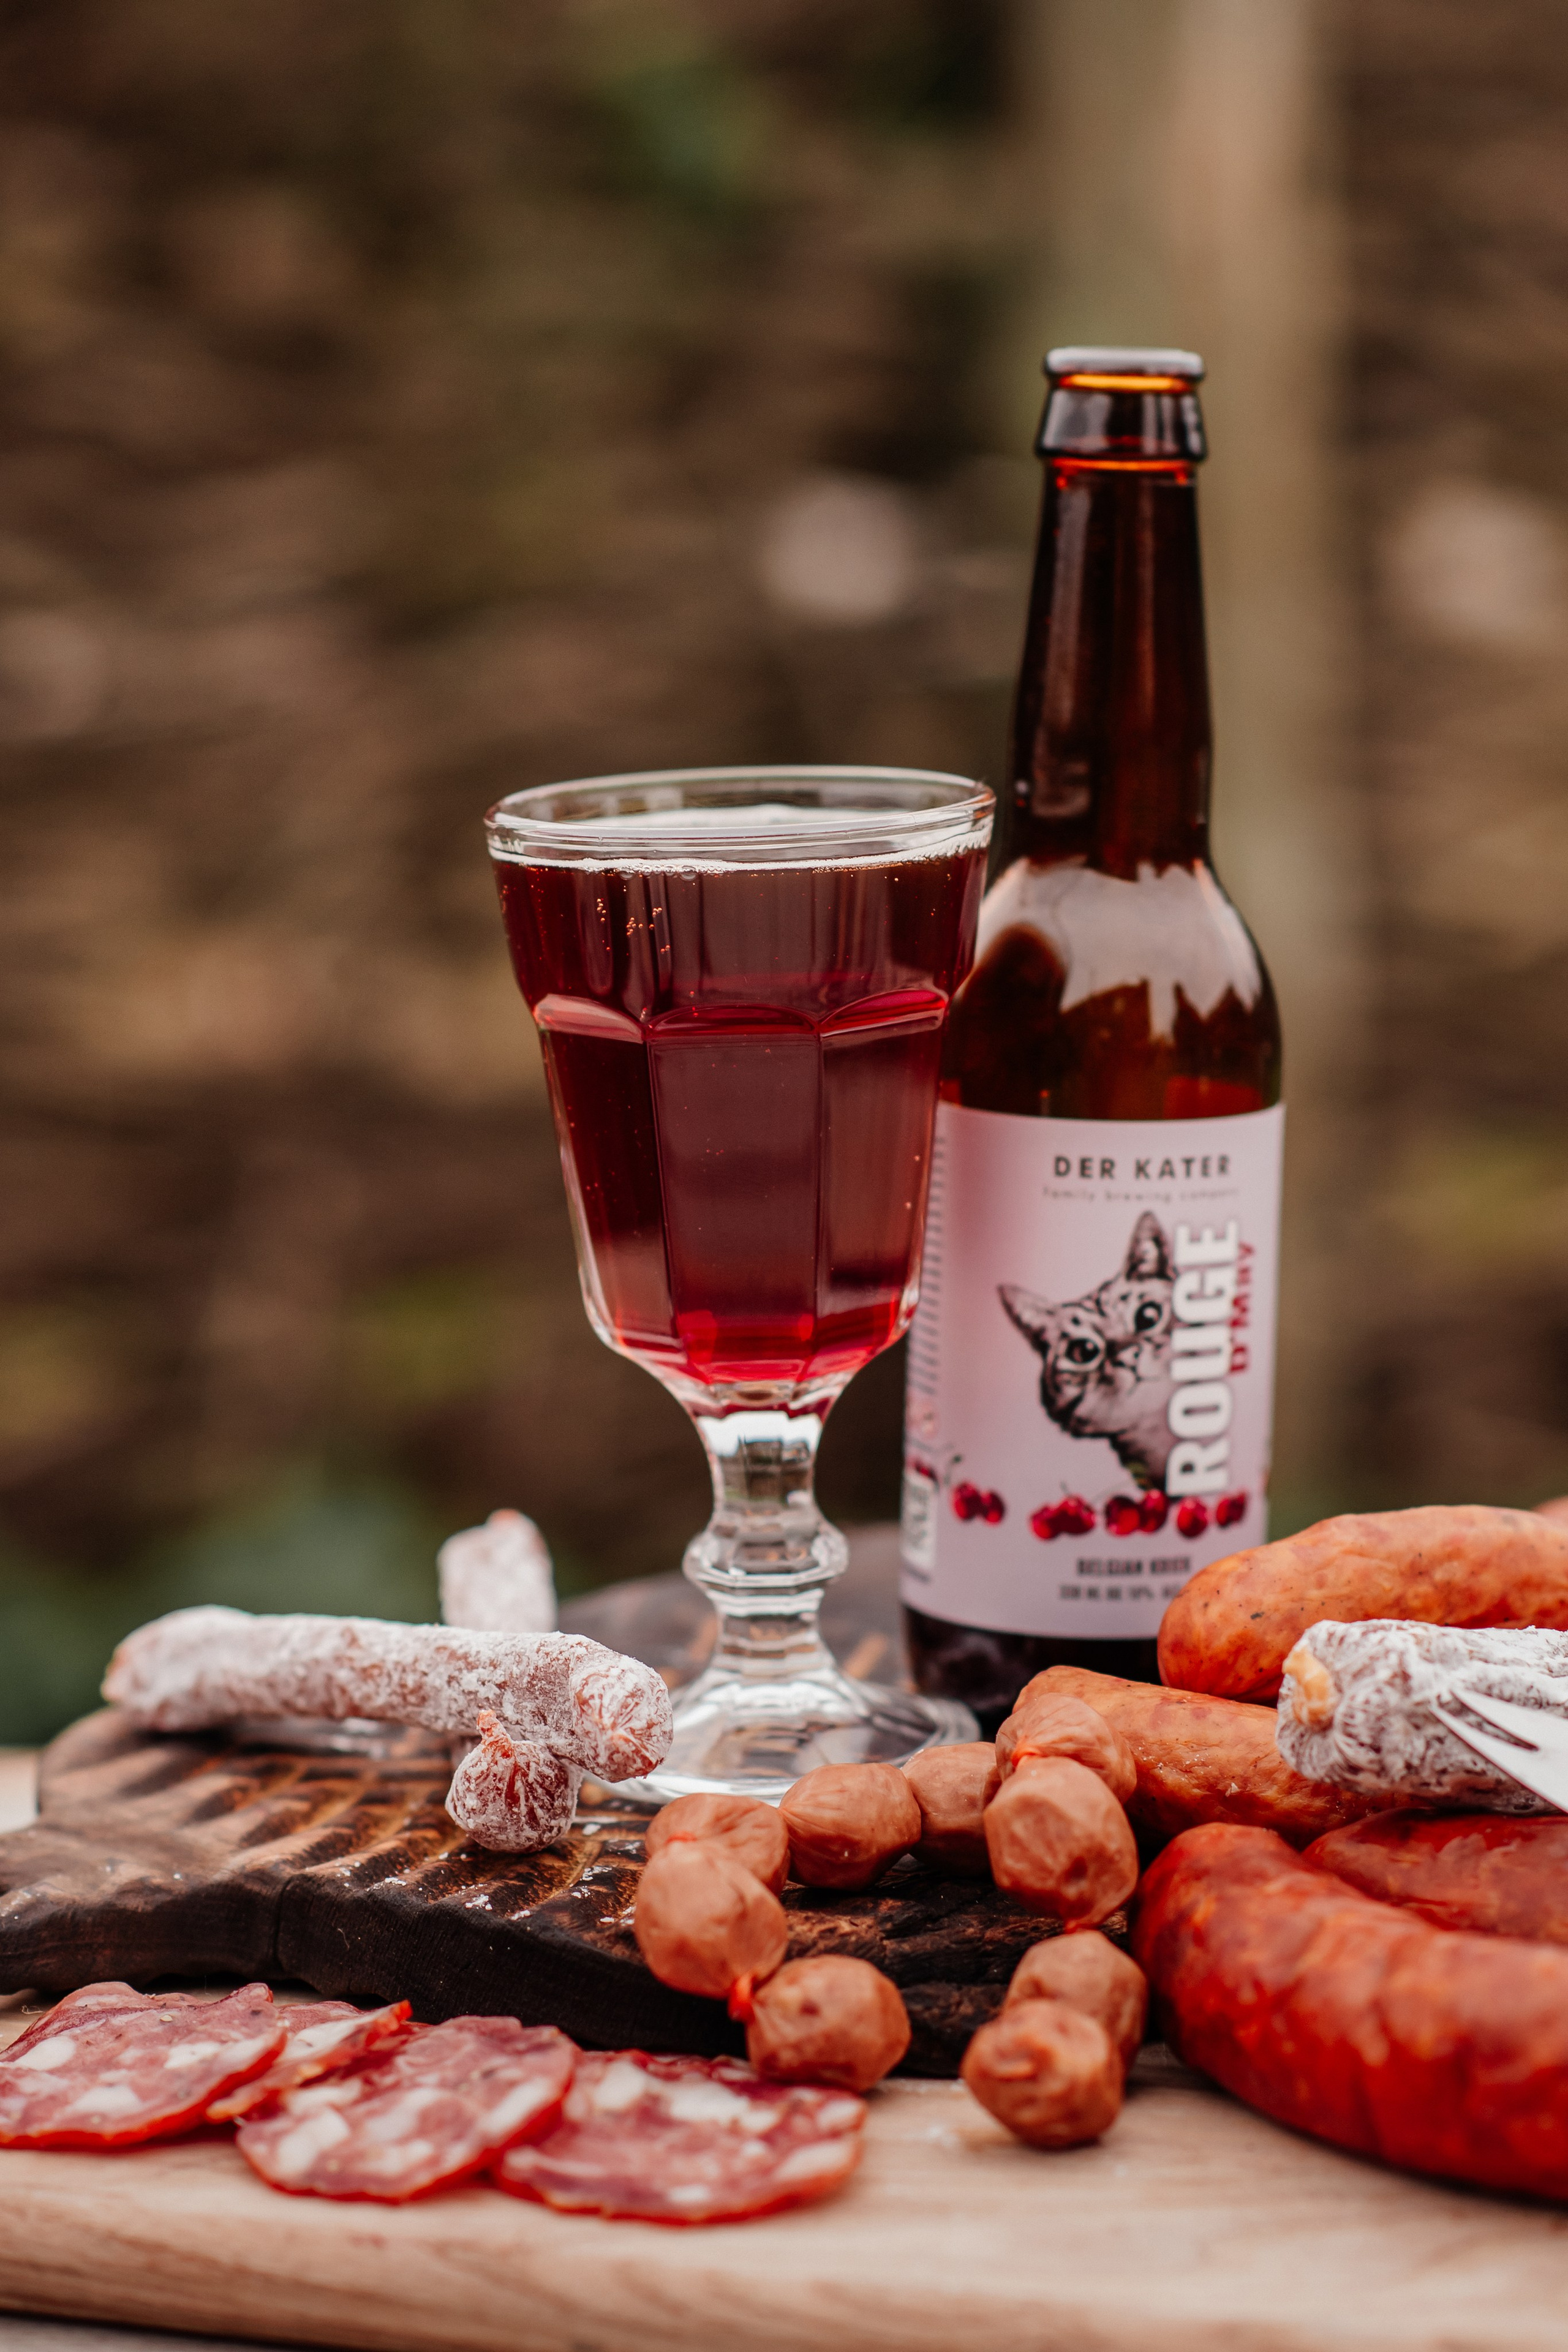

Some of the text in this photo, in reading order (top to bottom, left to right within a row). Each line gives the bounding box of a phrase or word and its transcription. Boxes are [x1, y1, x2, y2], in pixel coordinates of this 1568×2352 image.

[1054, 1154, 1231, 1180] DER KATER
[1166, 1221, 1238, 1496] ROUGE
